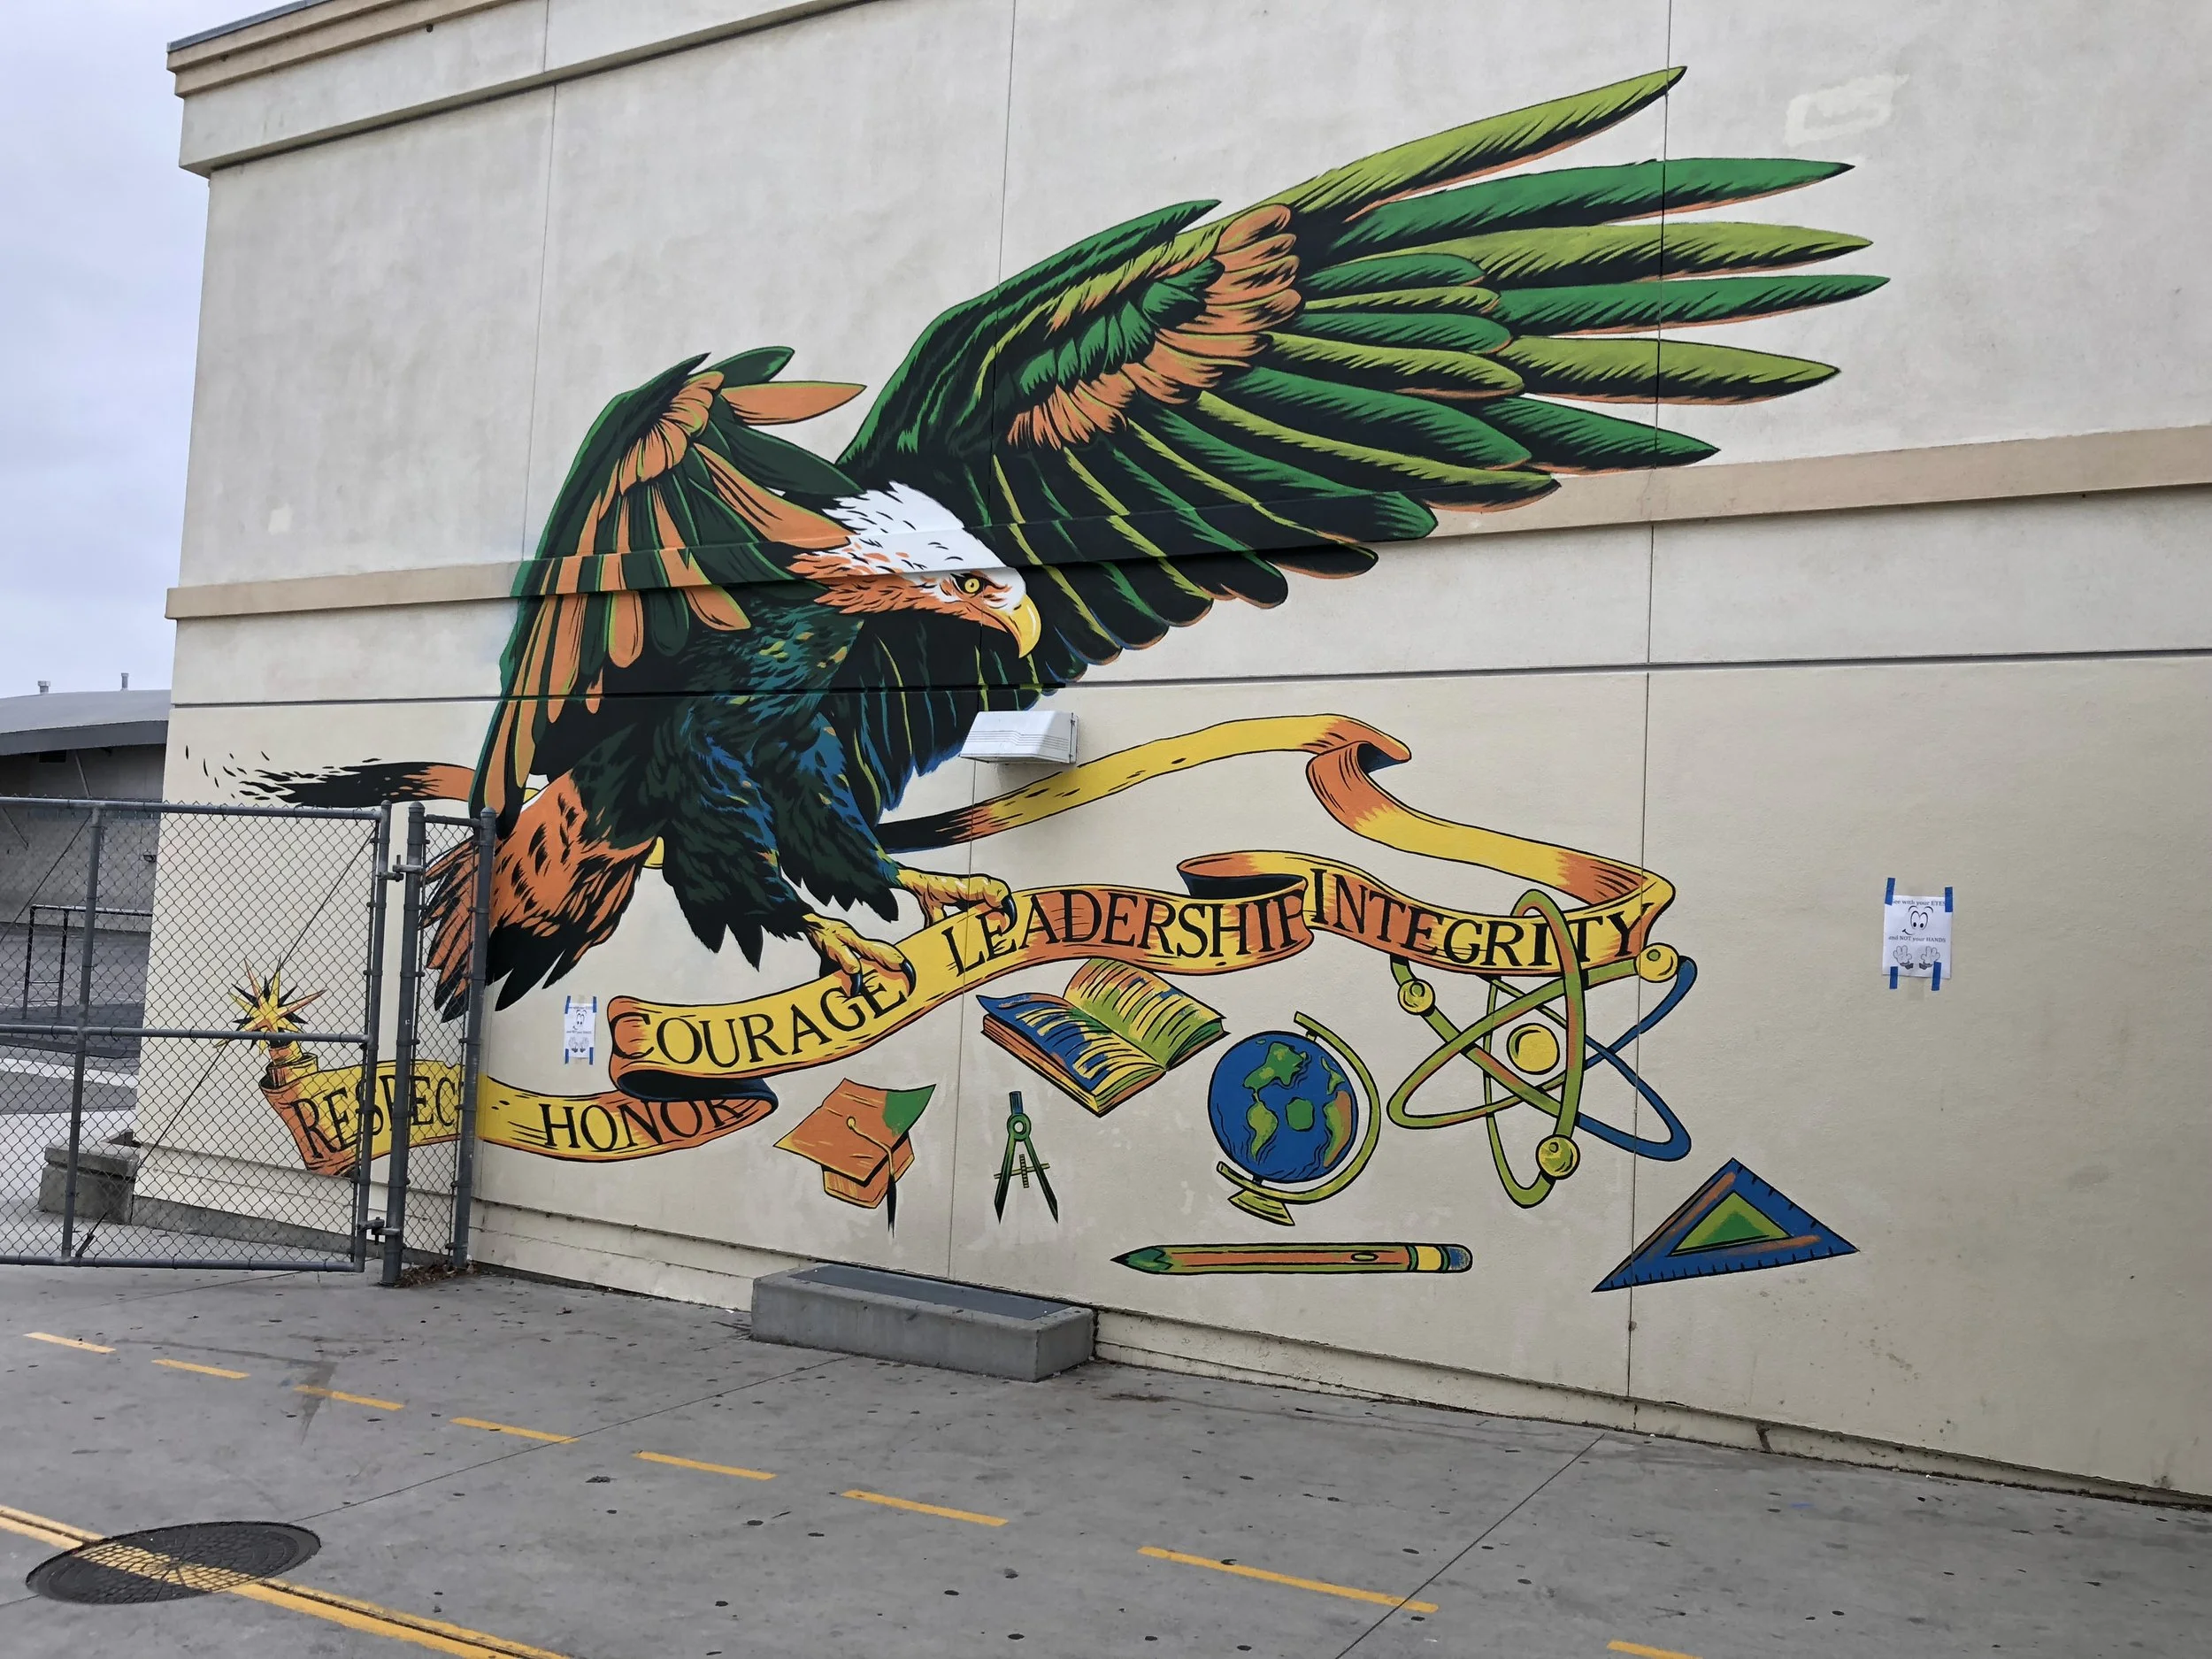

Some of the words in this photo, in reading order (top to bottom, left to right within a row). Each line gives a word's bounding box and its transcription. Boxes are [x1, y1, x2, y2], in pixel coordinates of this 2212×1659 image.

[941, 889, 1304, 977] LEADERSHIP
[1309, 868, 1655, 967] INTEGRITY
[611, 968, 909, 1068] COURAGE
[538, 1099, 745, 1151] HONOR
